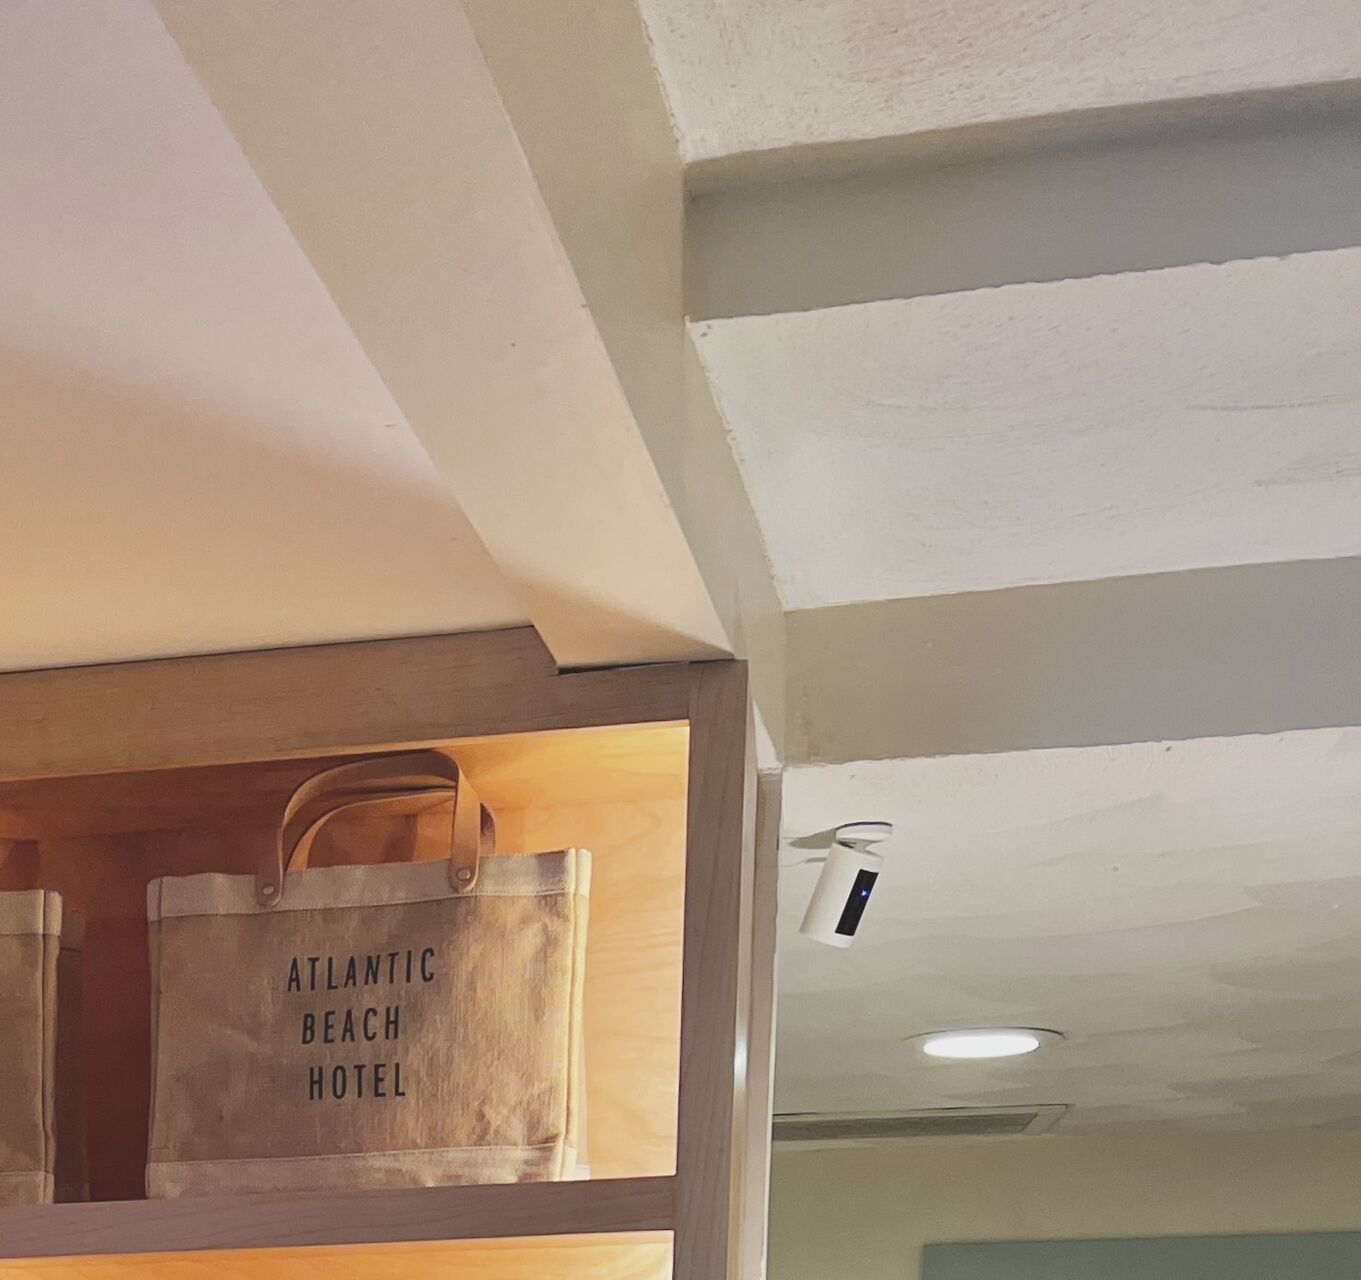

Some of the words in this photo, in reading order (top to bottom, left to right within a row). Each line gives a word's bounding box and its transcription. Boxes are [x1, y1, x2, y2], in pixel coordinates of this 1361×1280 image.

[287, 947, 436, 992] ATLANTIC
[301, 1005, 400, 1045] BEACH
[308, 1062, 406, 1100] HOTEL
